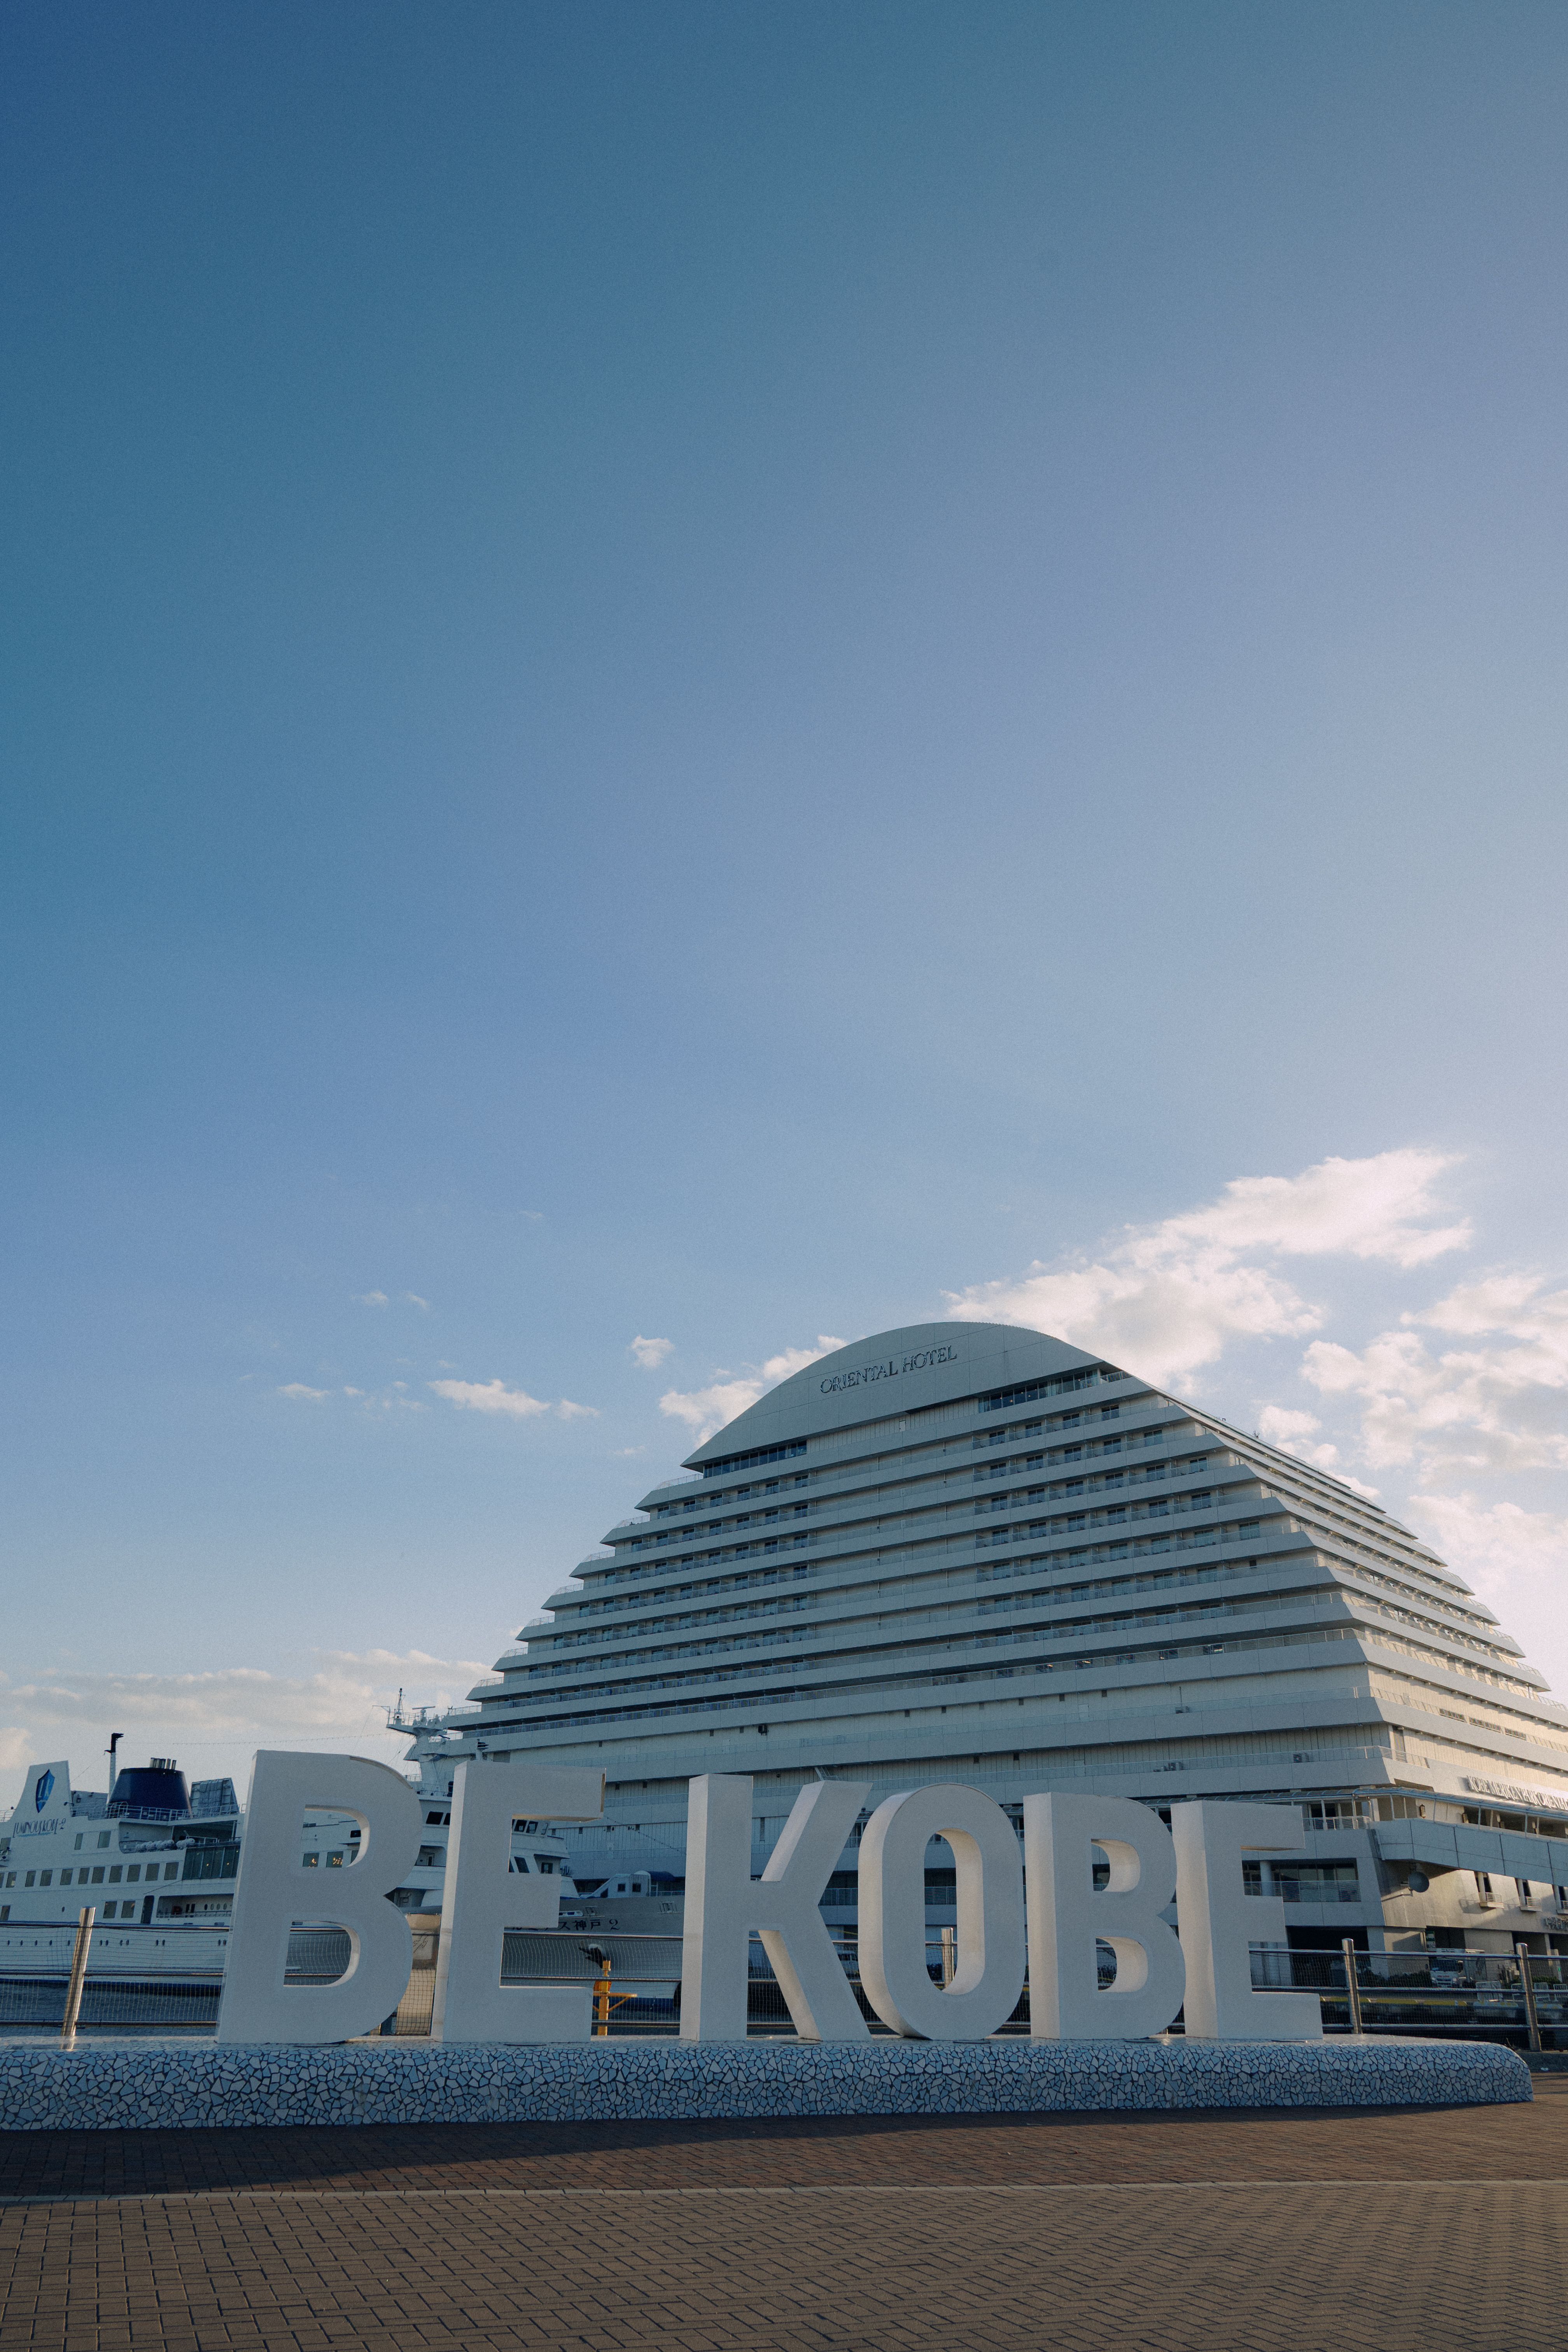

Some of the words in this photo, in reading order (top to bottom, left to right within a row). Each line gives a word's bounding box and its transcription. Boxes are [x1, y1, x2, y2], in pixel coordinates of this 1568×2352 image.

[820, 1361, 898, 1393] ORIENTAL
[902, 1345, 957, 1373] HOTEL
[1466, 1775, 1490, 1793] KOBE
[217, 1750, 606, 2044] BE
[680, 1774, 1323, 2041] KOBE
